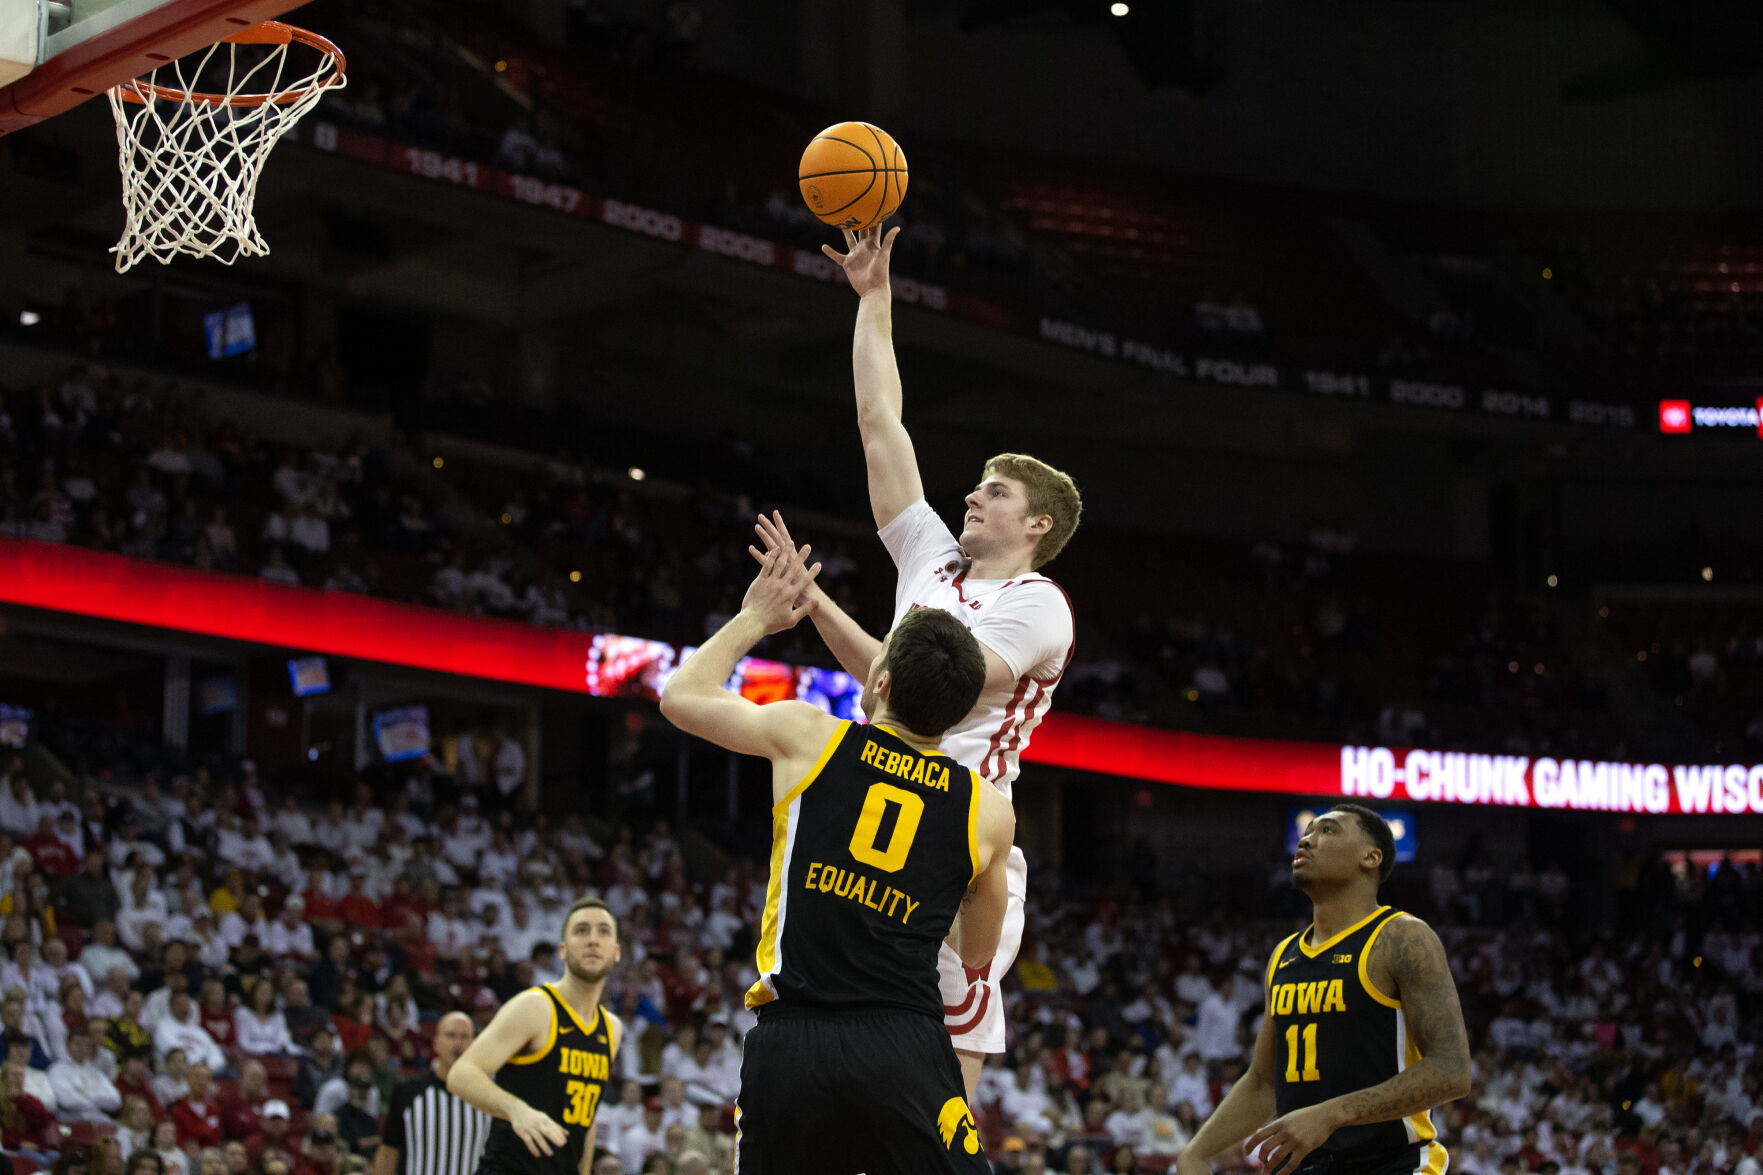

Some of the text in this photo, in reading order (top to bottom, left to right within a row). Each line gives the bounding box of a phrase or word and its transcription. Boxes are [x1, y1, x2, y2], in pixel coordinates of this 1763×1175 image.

[405, 147, 479, 188] 1941
[510, 174, 581, 213] 1947
[603, 197, 682, 242] 2000
[1121, 338, 1191, 377] FINAL
[1196, 357, 1279, 388] FOUR
[1304, 370, 1370, 398] 1941
[1389, 378, 1465, 408] 2000
[1692, 406, 1759, 427] TOYOTA
[860, 739, 950, 792] REBRACA
[1340, 744, 1532, 804] HO-CHUNK
[1532, 757, 1670, 813] GAMING
[848, 781, 925, 874] 0
[805, 862, 920, 925] EQUALITY
[1270, 978, 1347, 1016] IOWA
[558, 1046, 610, 1081] IOWA
[1285, 1022, 1320, 1083] 11
[562, 1079, 602, 1128] 30
